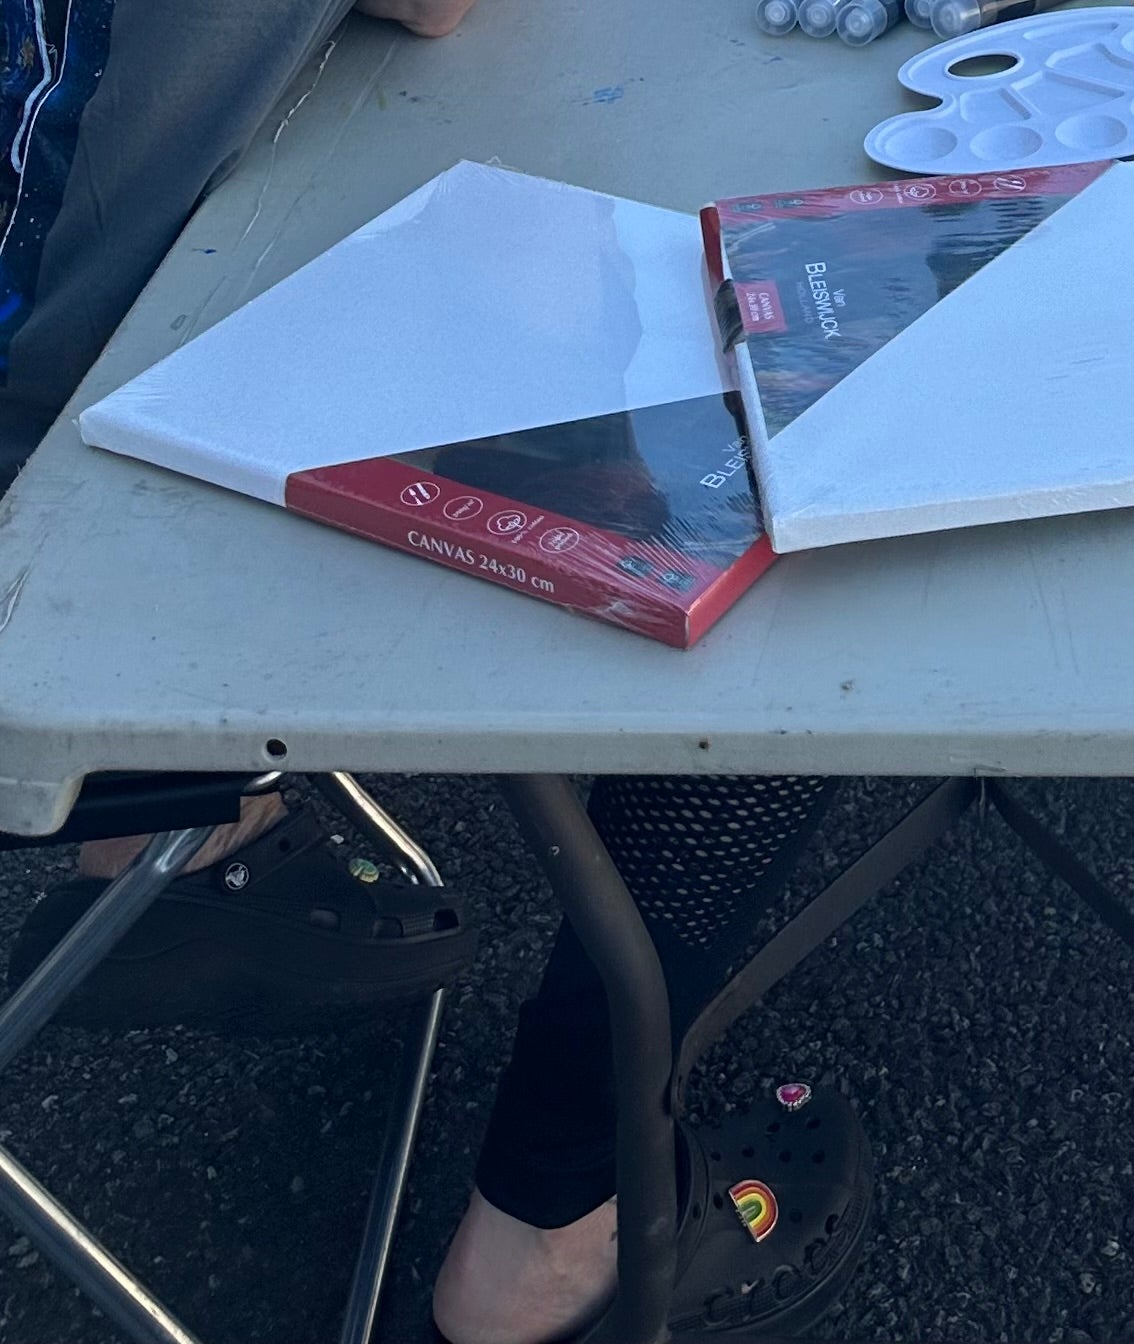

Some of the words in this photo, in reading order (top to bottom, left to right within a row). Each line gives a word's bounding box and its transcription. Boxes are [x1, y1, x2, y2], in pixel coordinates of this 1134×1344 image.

[759, 292, 774, 320] CANVAS
[832, 289, 847, 308] Van
[407, 530, 475, 565] CANVAS
[479, 554, 526, 583] 24x30
[531, 575, 555, 593] cm
